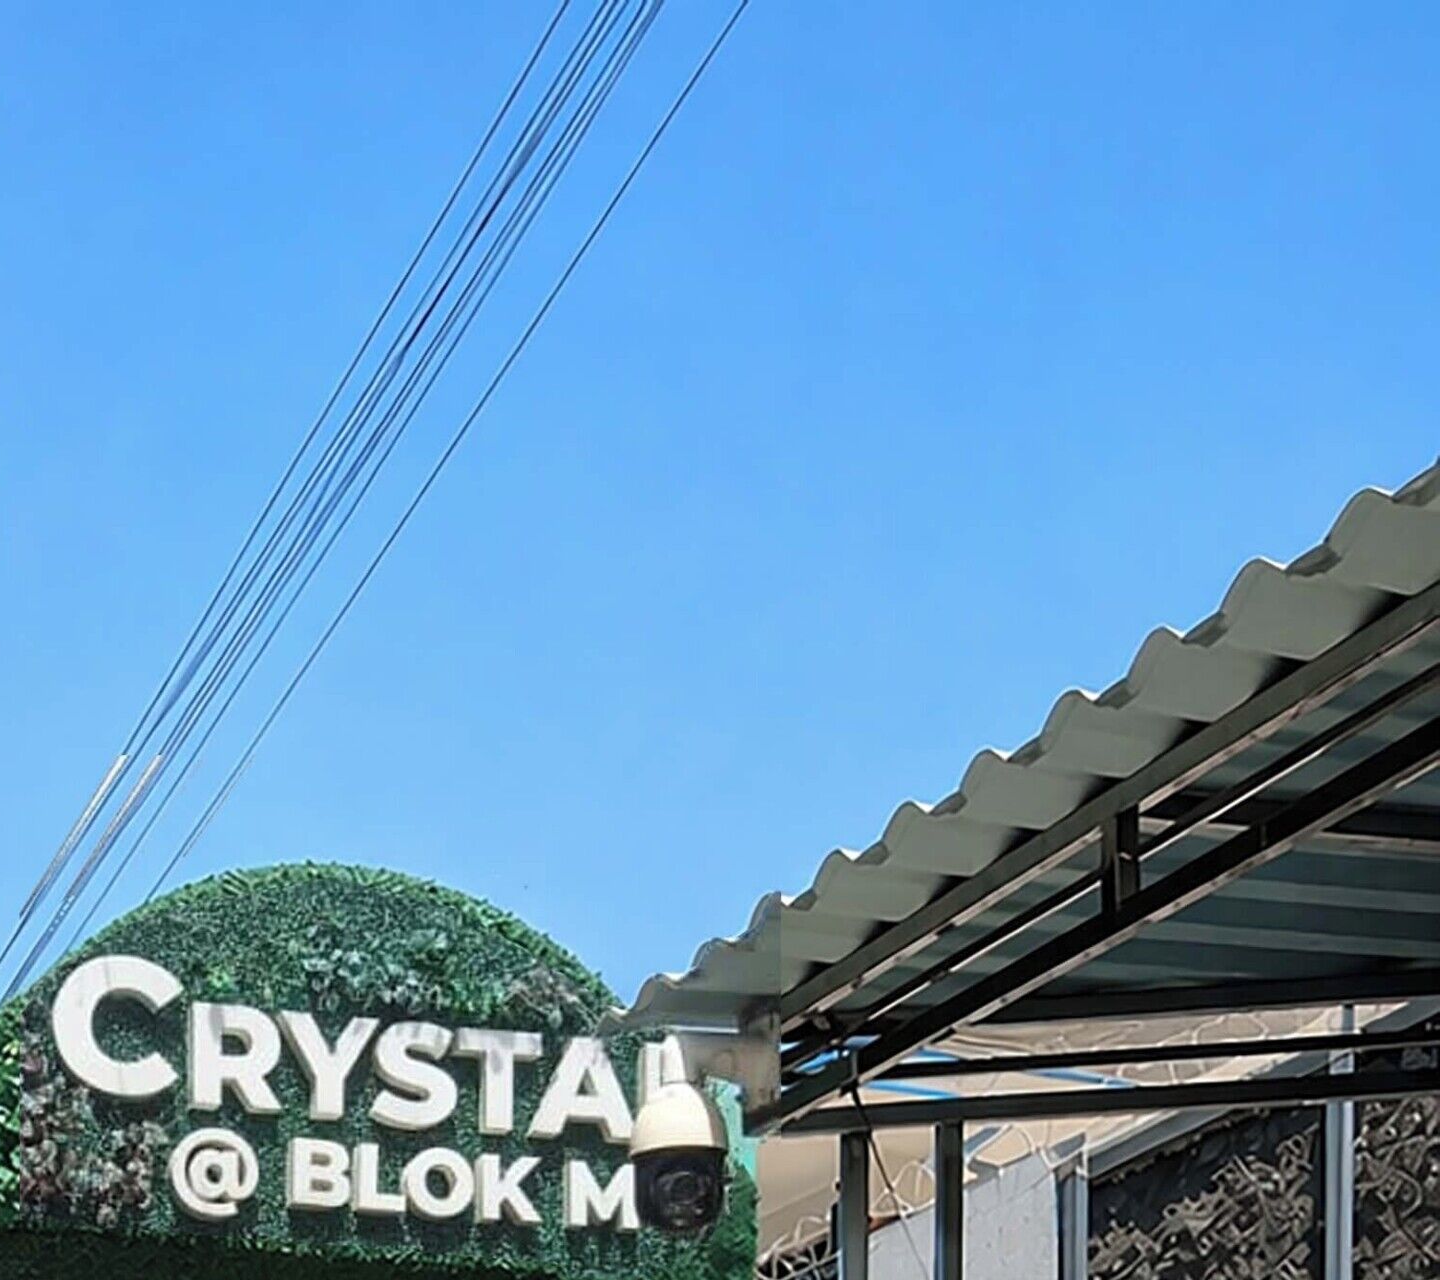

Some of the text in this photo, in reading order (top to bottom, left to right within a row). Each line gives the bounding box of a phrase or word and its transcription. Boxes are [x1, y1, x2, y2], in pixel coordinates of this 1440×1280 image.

[169, 1127, 641, 1233] @ BLOK M
